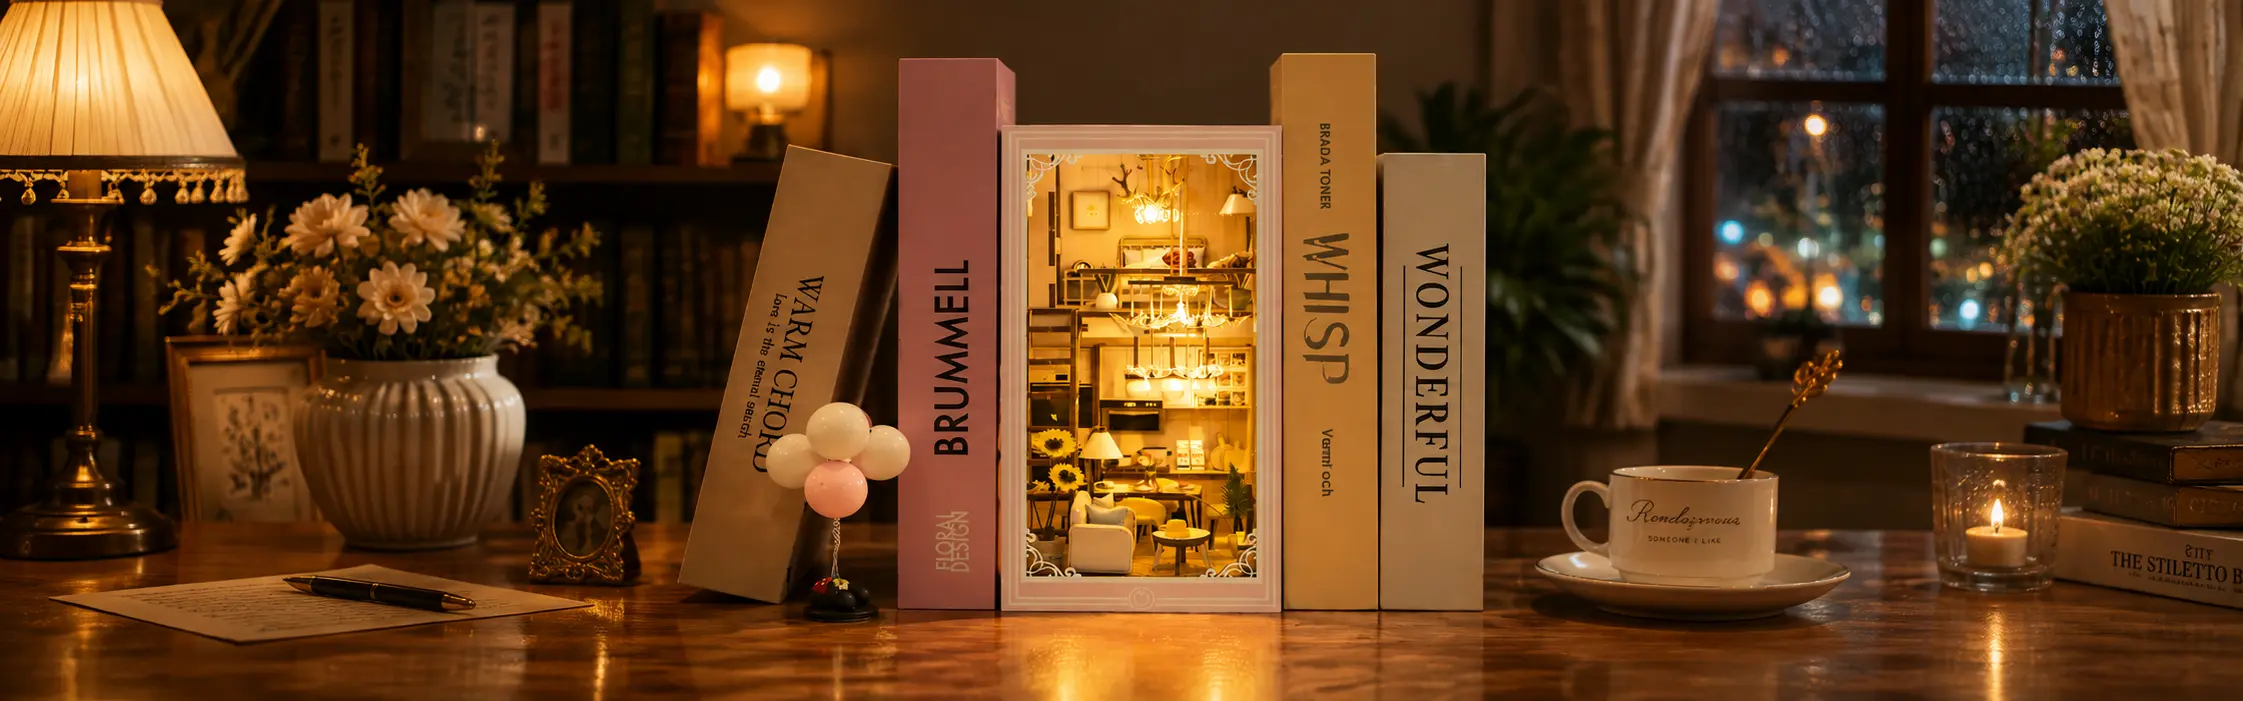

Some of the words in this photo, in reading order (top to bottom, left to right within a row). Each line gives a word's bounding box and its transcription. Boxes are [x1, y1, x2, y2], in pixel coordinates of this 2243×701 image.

[1319, 123, 1331, 166] BRADA
[1319, 169, 1332, 209] TONER
[779, 276, 825, 363] WARM
[1303, 232, 1350, 385] WHISP
[934, 260, 969, 455] BRUMMELL
[1415, 243, 1449, 504] WONDERFUL
[1322, 471, 1334, 497] och
[935, 515, 954, 571] FLORAL
[949, 511, 970, 573] DESIGN
[1648, 535, 1690, 544] SOMEONE
[2110, 550, 2143, 571] THE
[2147, 556, 2228, 583] STILETTO
